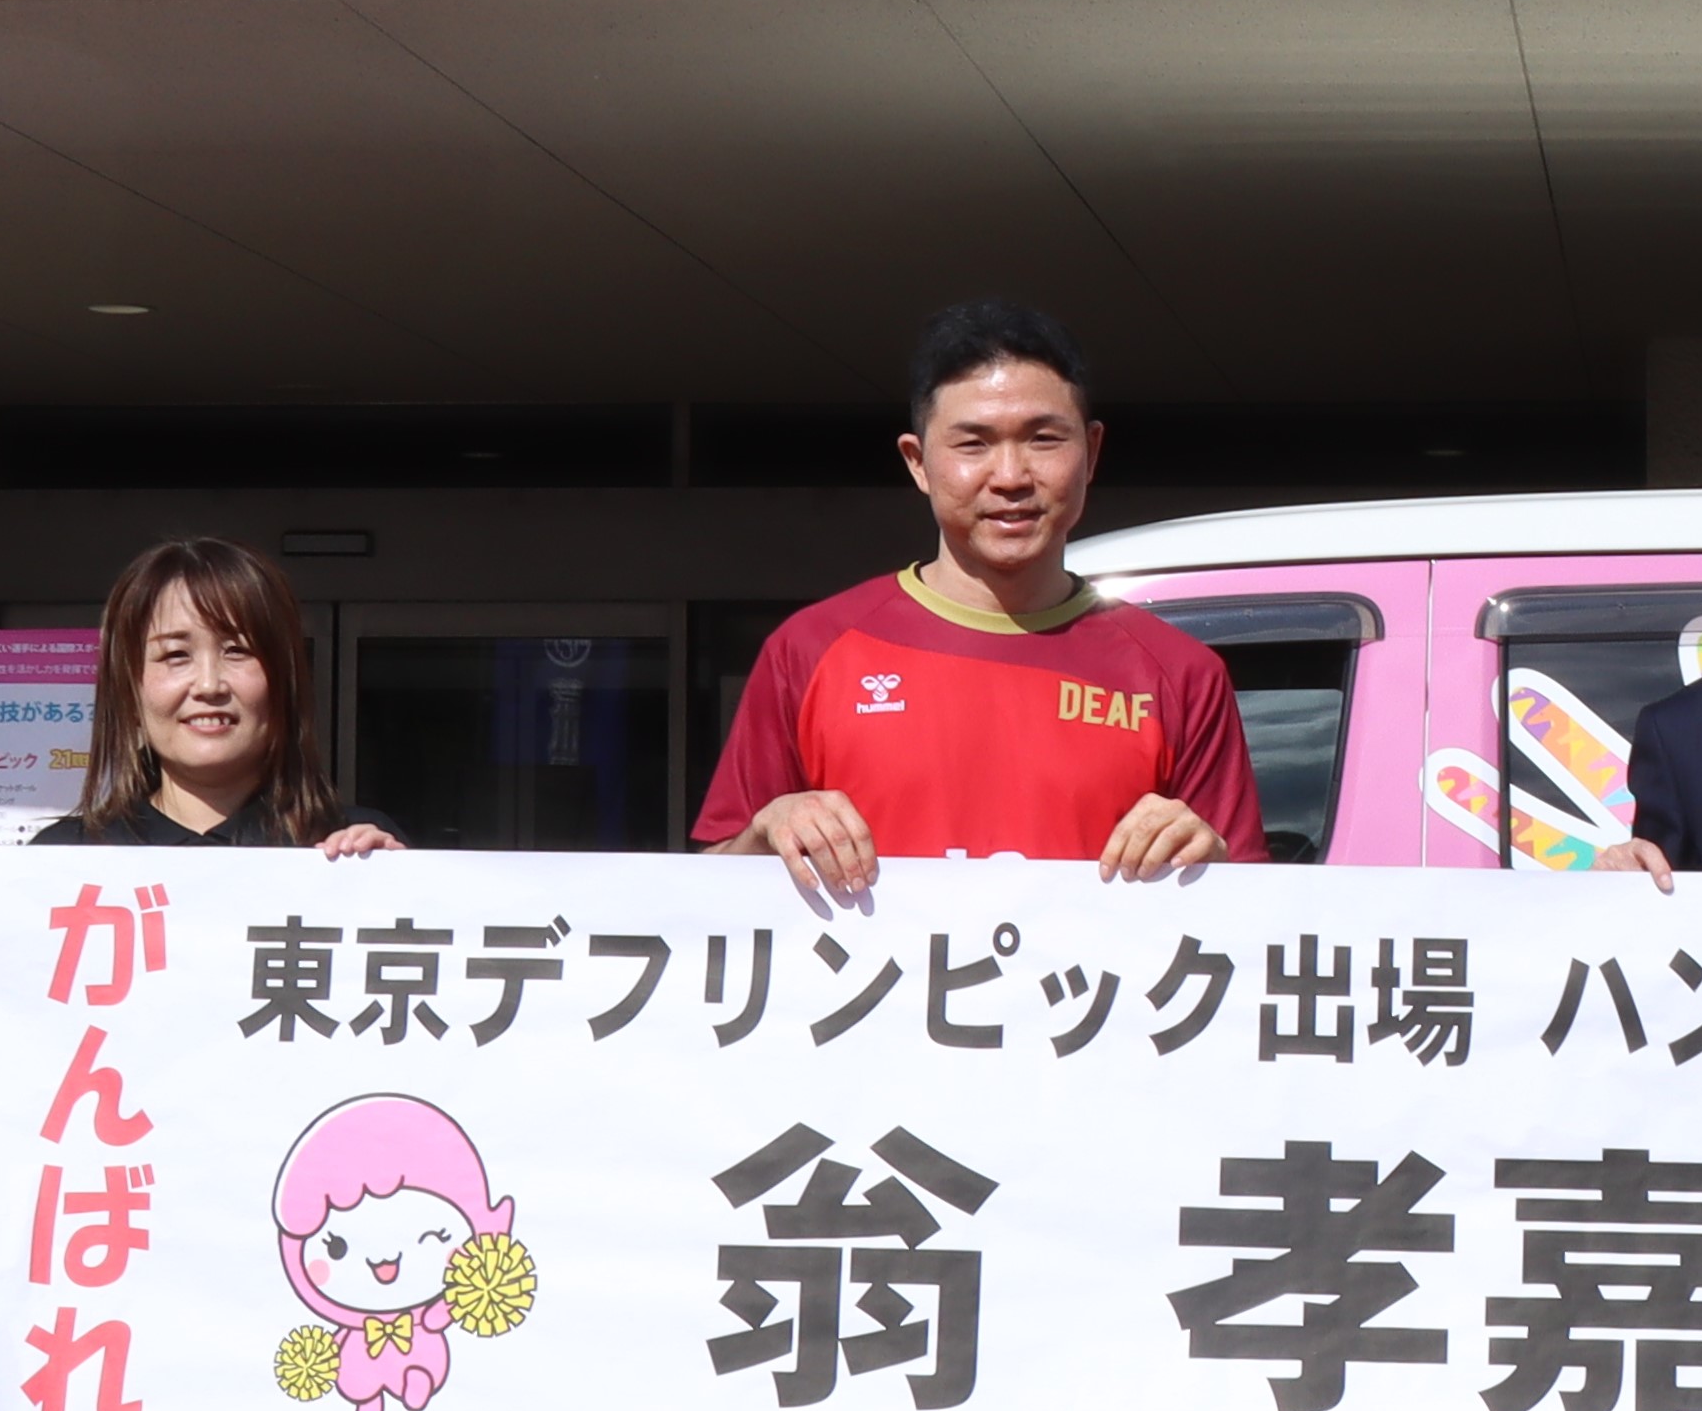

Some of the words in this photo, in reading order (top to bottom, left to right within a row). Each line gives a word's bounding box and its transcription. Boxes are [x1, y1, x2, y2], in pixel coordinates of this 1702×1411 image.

[857, 699, 906, 715] hummel
[1058, 680, 1154, 734] DEAF
[239, 916, 1473, 1065] 東京デフリンピック出場
[707, 1123, 999, 1410] 翁
